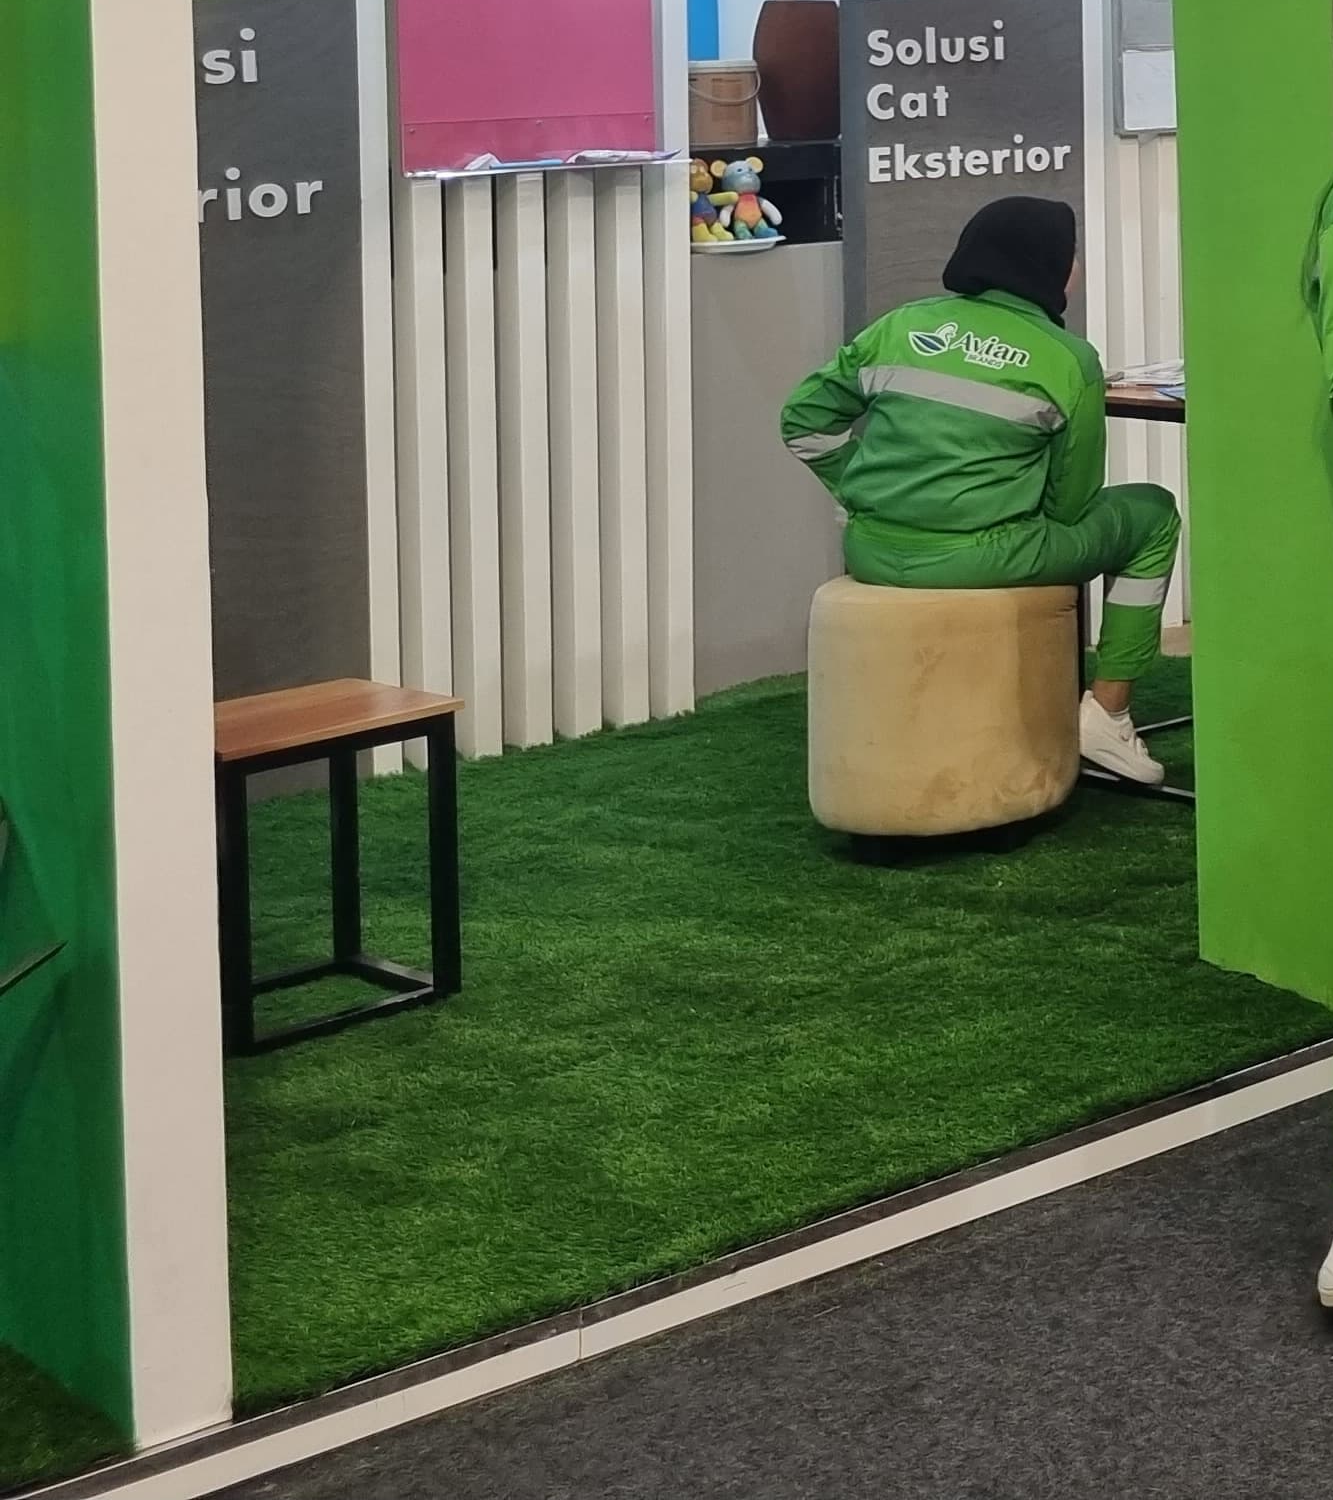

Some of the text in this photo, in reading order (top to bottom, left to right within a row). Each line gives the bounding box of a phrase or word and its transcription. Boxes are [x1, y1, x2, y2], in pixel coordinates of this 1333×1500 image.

[866, 20, 1006, 67] Solusi
[866, 83, 950, 120] Cat
[867, 134, 1072, 184] Eksterior
[950, 331, 1030, 367] Avian
